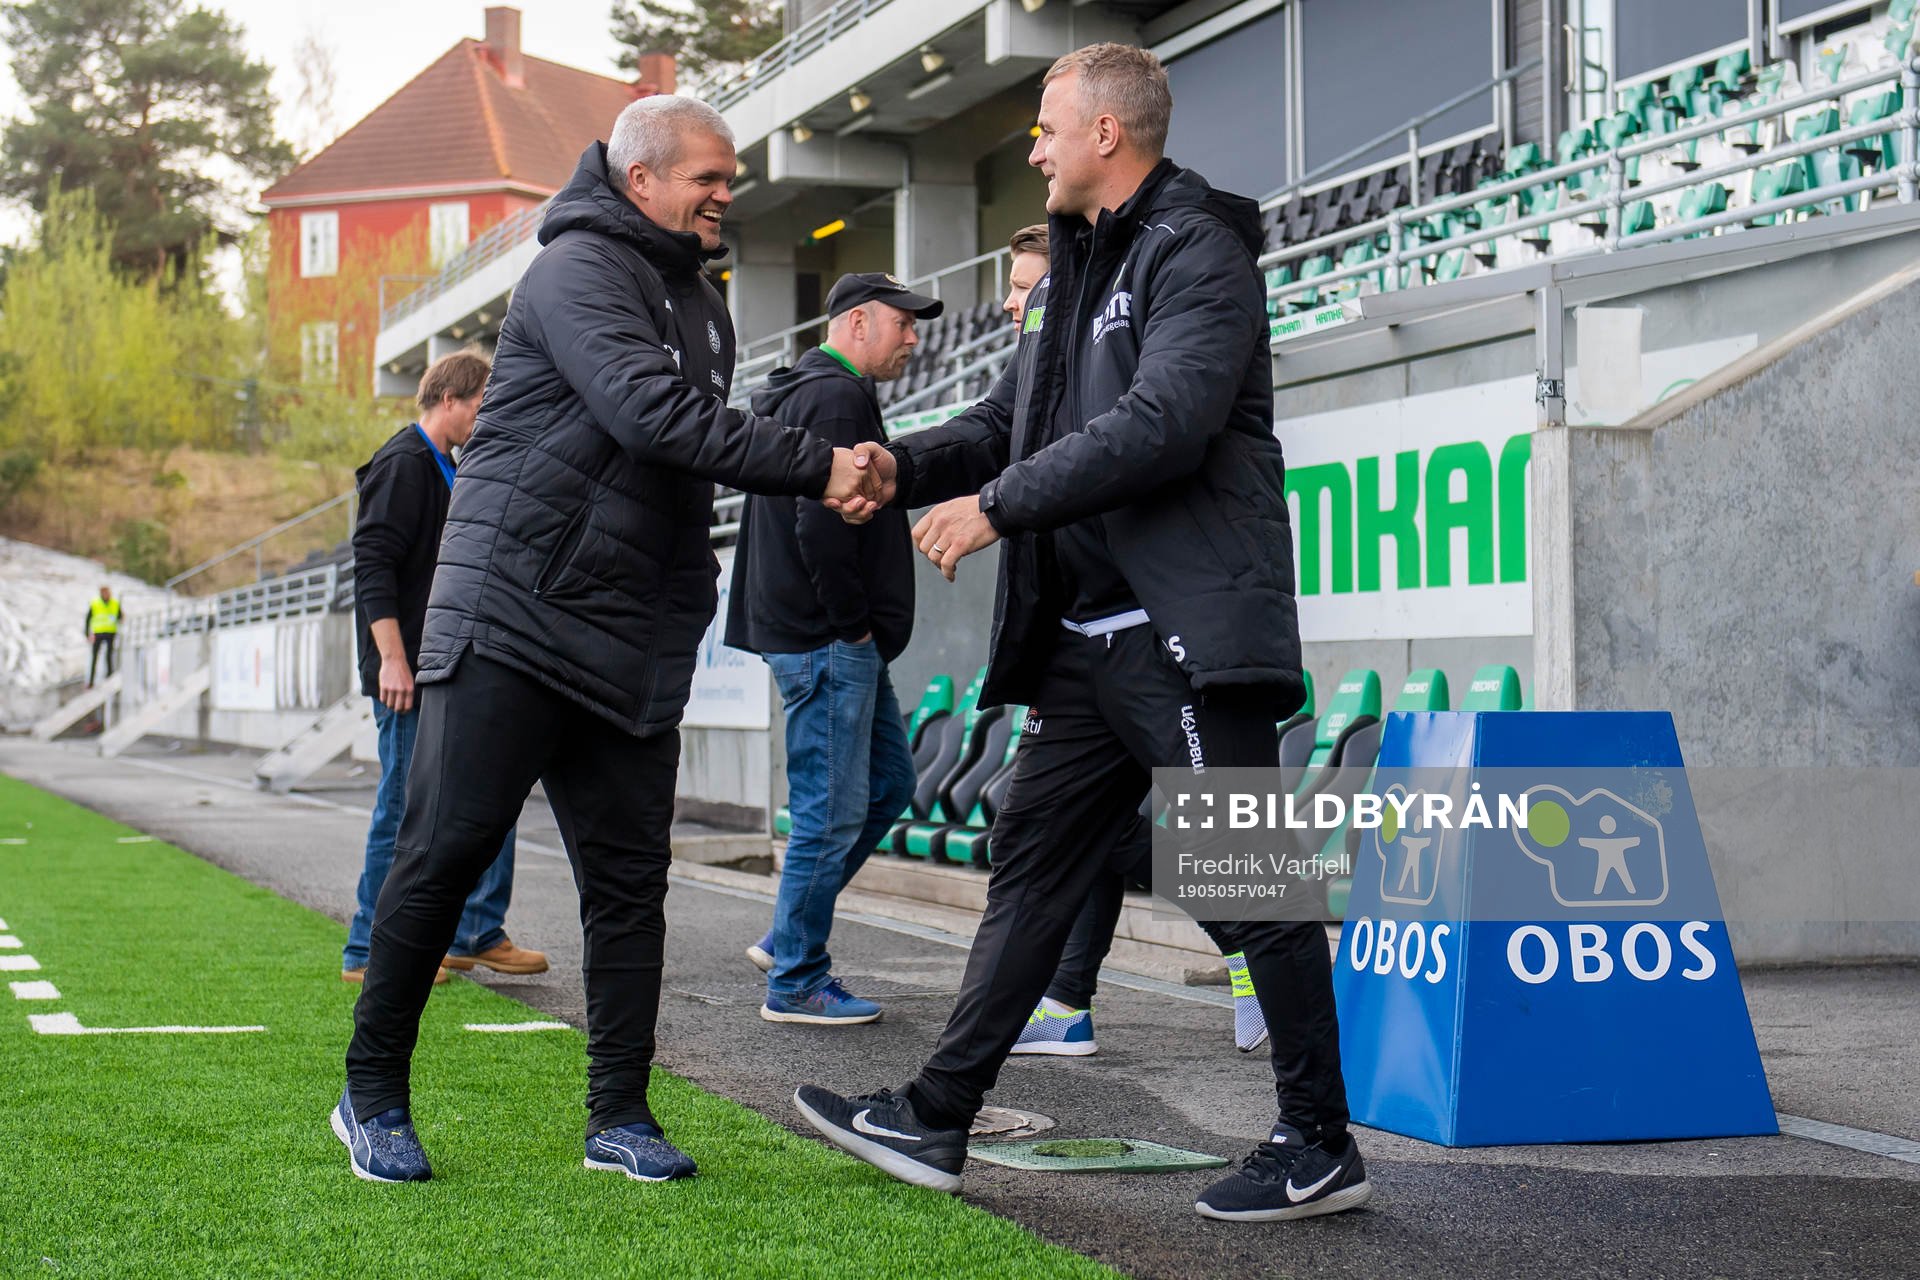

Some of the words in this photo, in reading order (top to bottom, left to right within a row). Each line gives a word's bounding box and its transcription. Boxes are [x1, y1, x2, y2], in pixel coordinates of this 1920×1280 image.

[1180, 705, 1206, 776] macron
[1350, 916, 1451, 984] OBOS
[1506, 920, 1717, 984] OBOS
